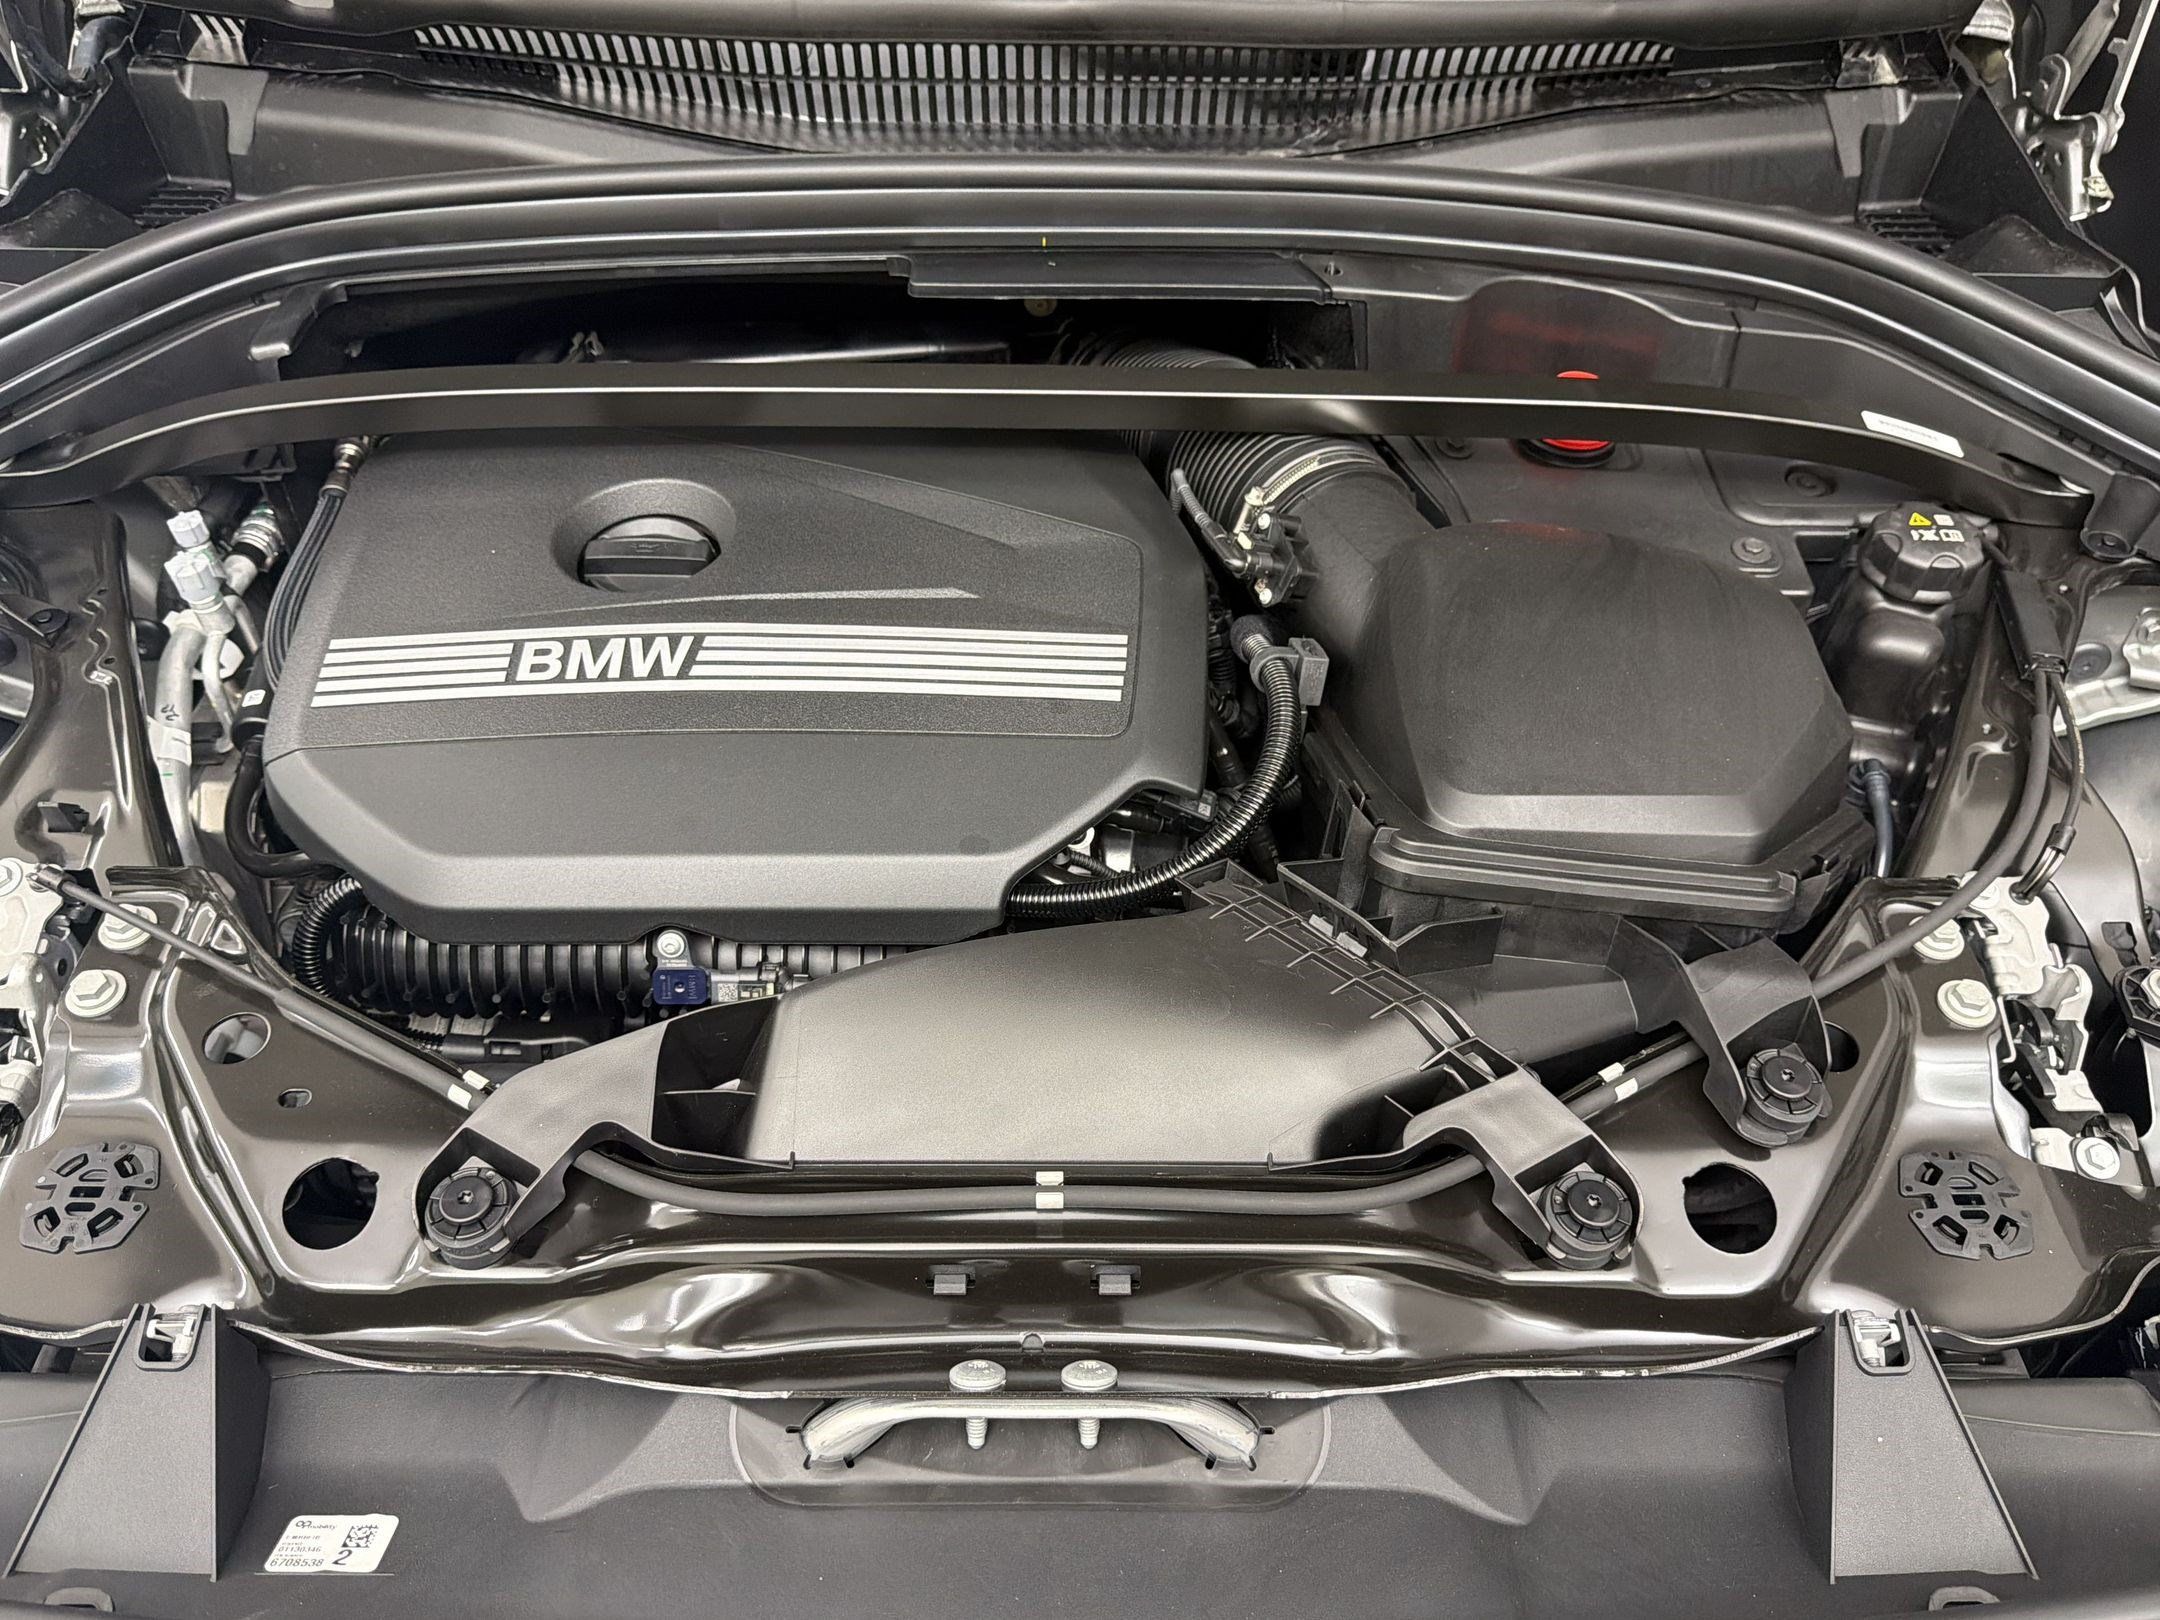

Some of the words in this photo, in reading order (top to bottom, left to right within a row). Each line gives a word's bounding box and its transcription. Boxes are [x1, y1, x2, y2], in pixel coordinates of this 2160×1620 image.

[516, 636, 694, 681] BMW
[269, 1558, 324, 1567] 6708538
[332, 1549, 352, 1566] 2
